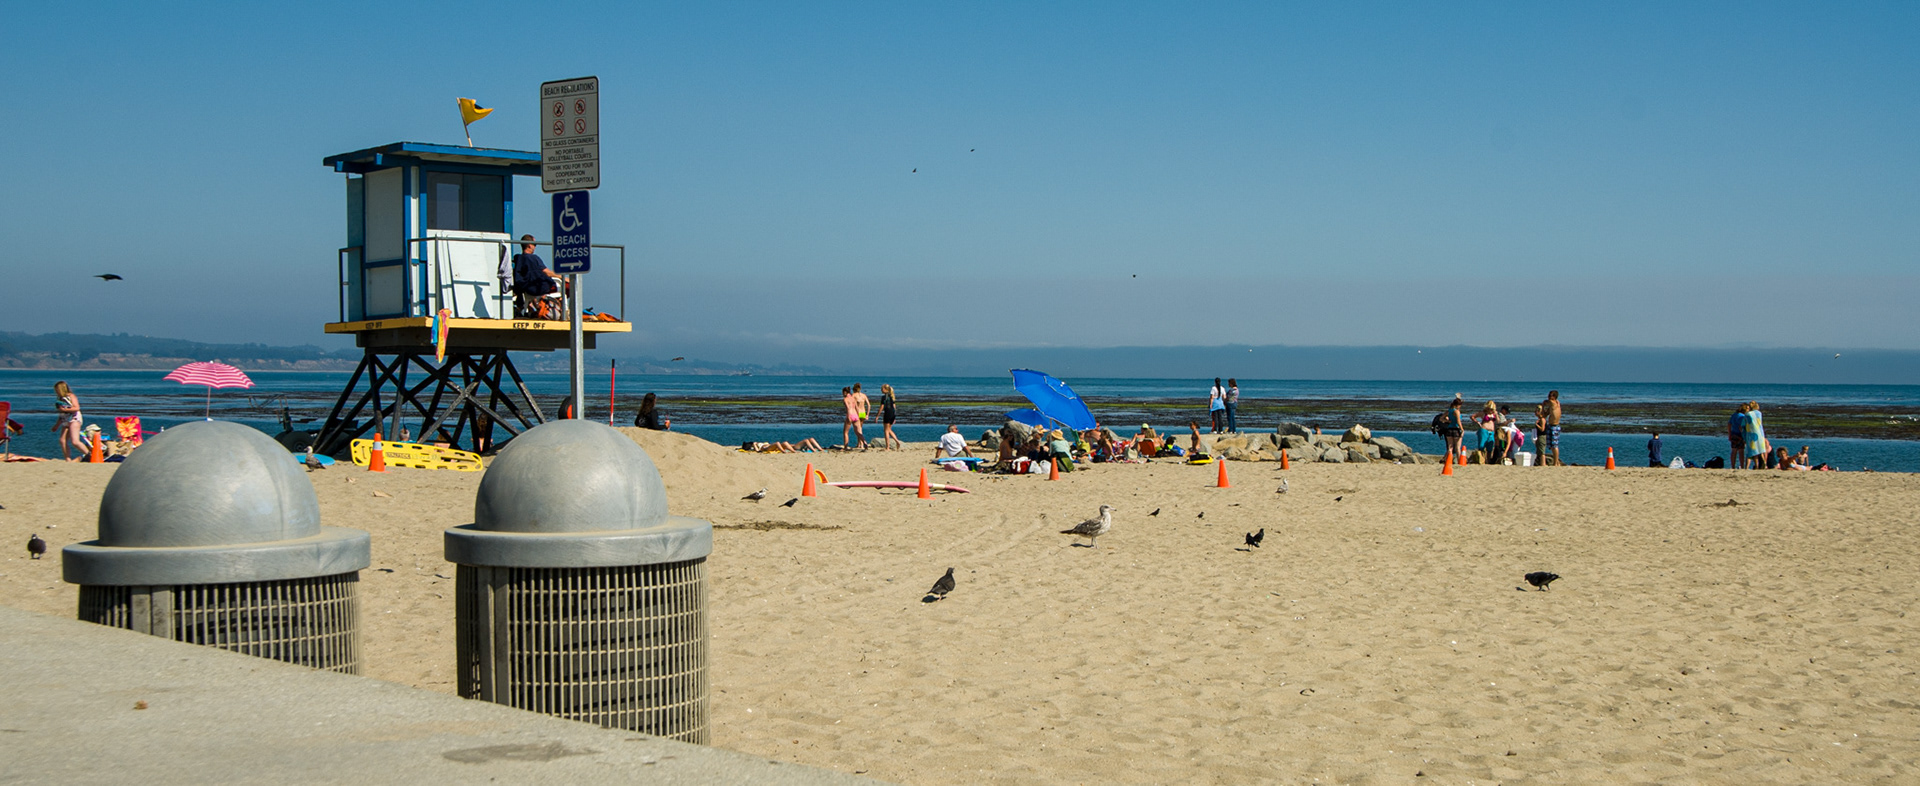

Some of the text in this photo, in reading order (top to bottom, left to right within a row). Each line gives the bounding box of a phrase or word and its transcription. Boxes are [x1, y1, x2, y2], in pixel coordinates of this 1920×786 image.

[544, 82, 594, 96] BEACH REGULATIONS
[557, 234, 586, 246] BEACH
[555, 247, 589, 259] ACCESS
